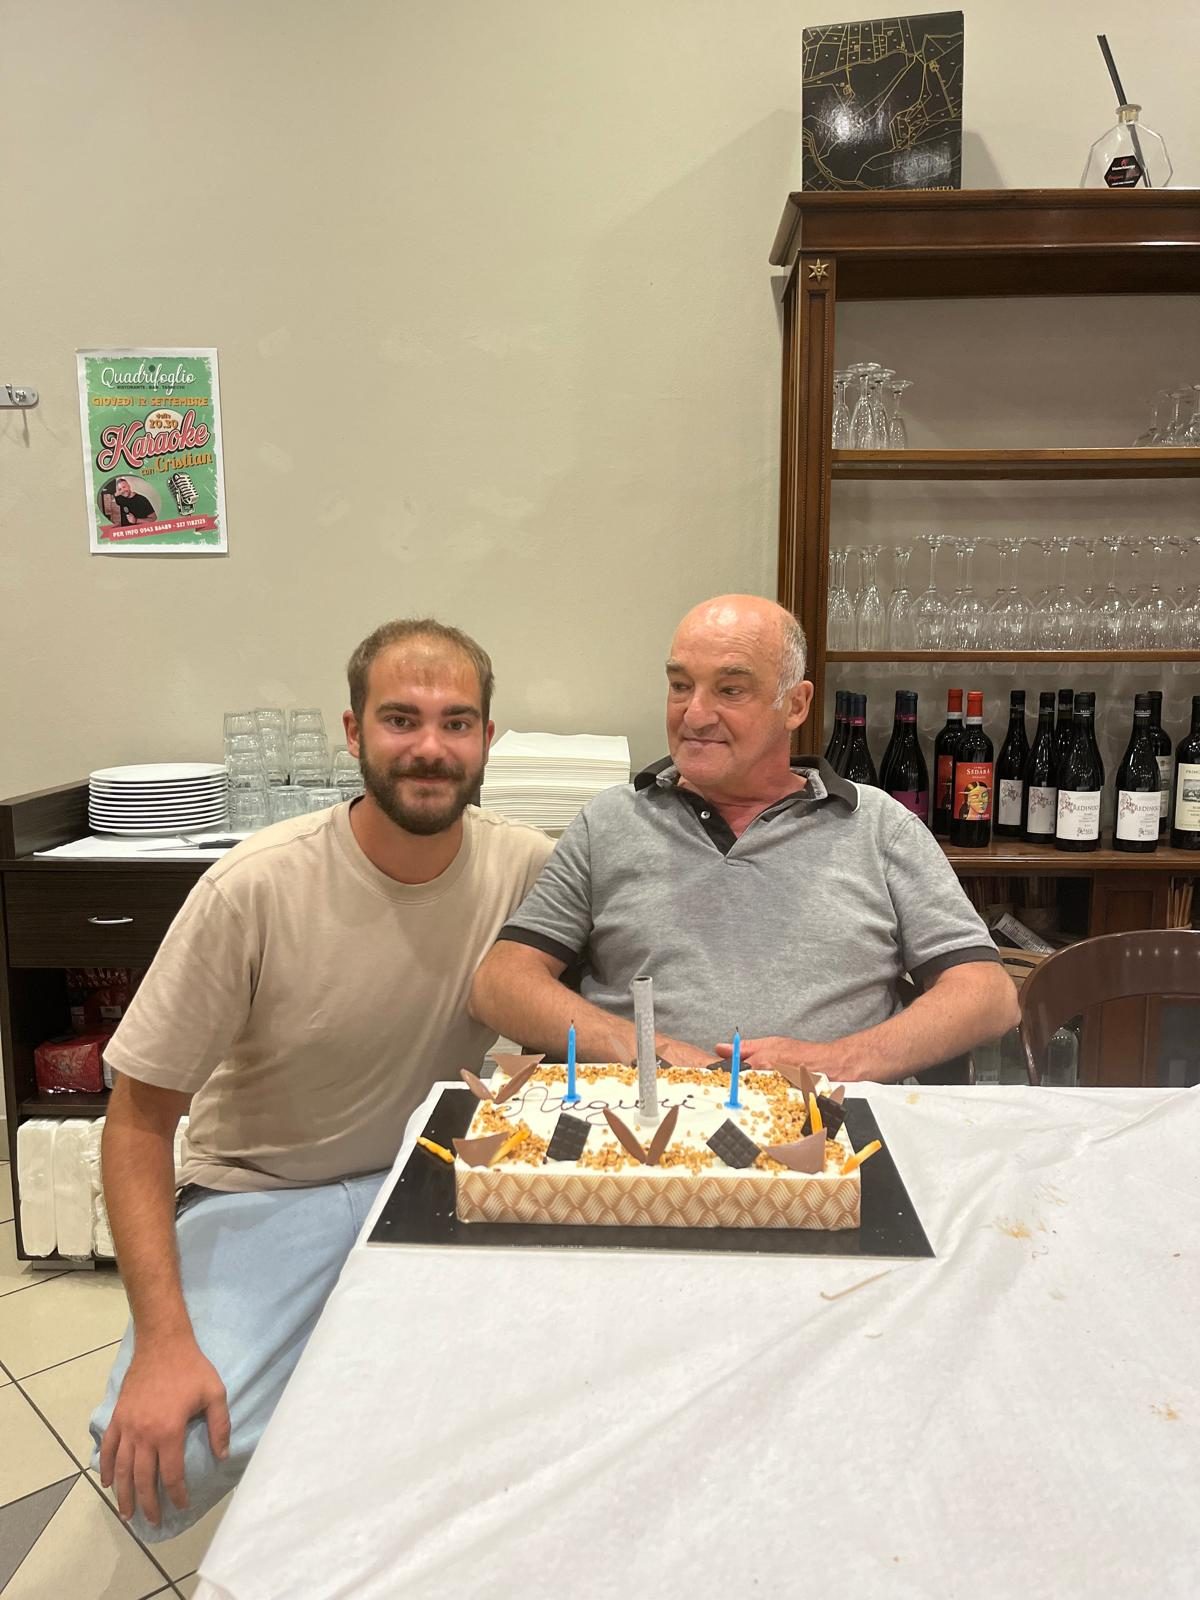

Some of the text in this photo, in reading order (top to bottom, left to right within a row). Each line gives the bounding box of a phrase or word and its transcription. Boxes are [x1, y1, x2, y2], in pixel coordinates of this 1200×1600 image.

[101, 362, 197, 395] Quadrifoglio
[151, 396, 209, 407] SETTEMBRE
[96, 409, 211, 472] Karaoke
[155, 453, 213, 473] Cristian
[125, 528, 139, 536] INFO
